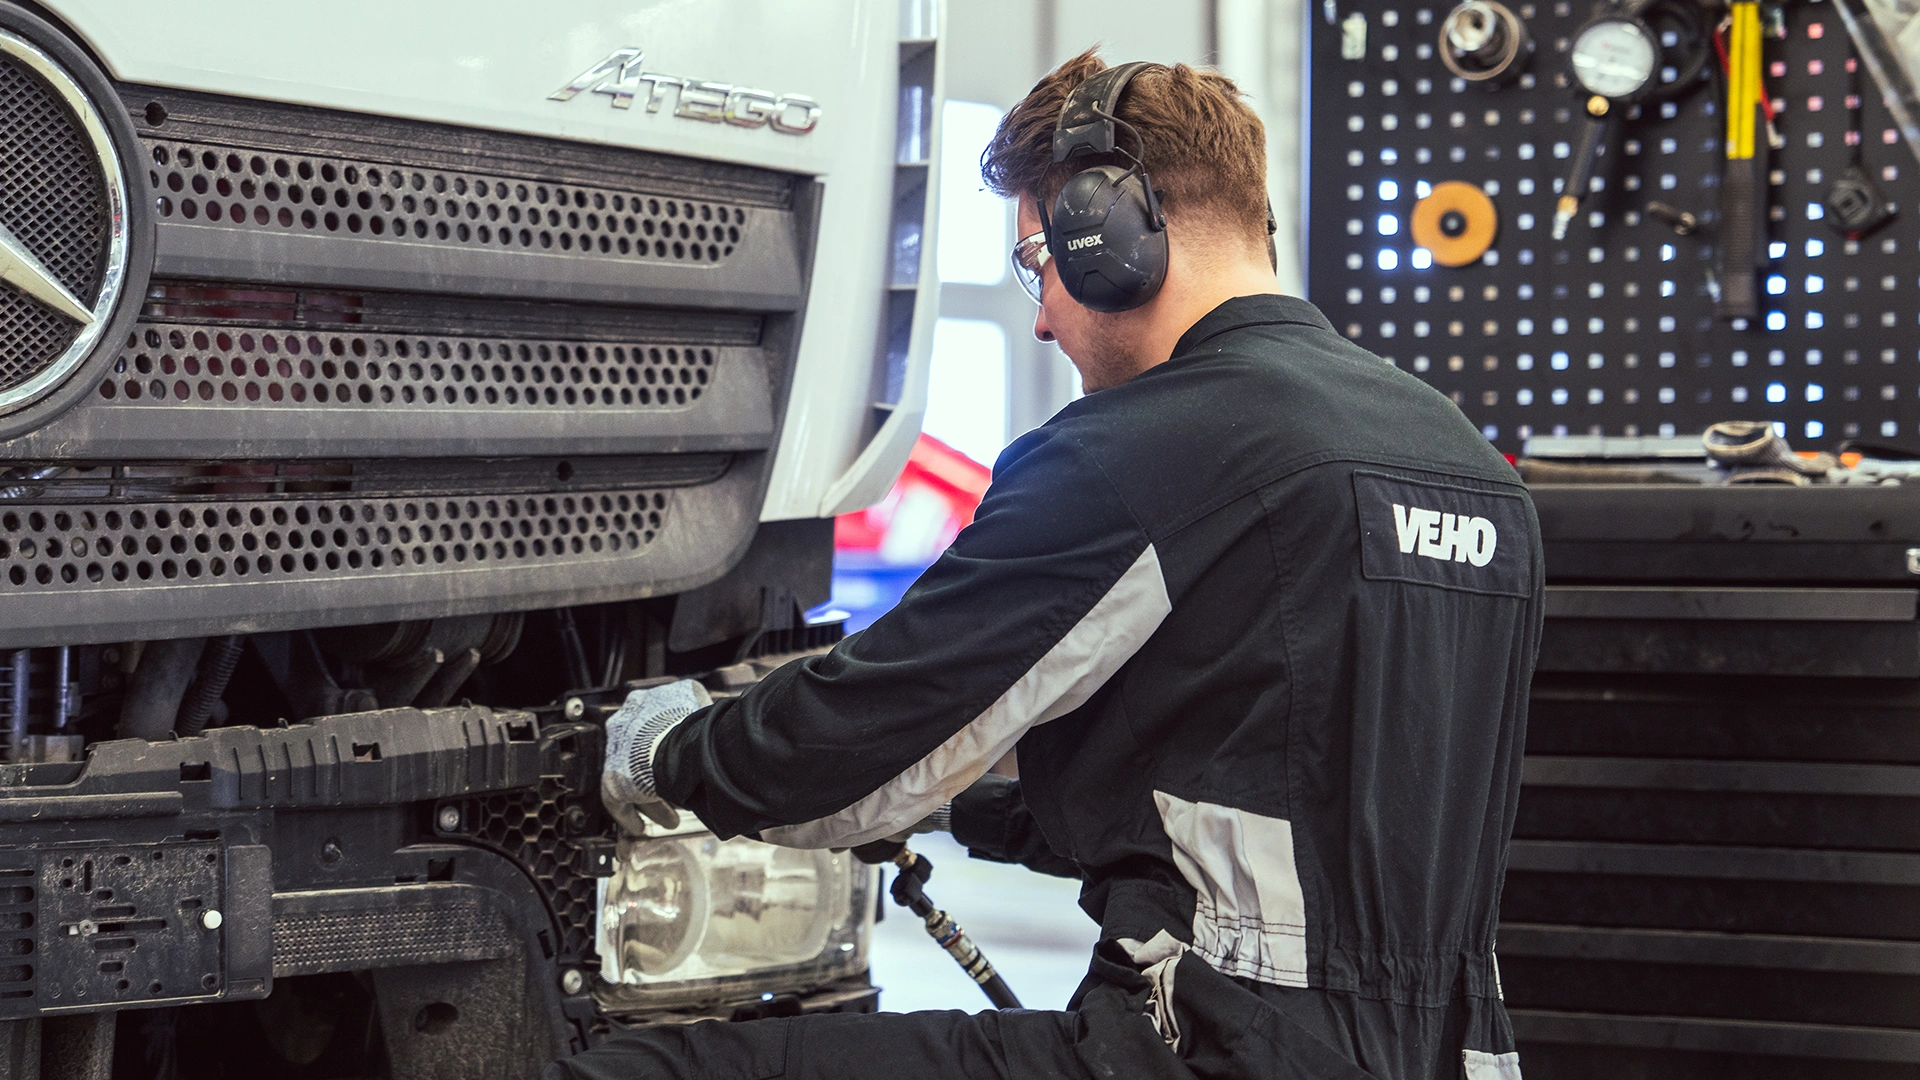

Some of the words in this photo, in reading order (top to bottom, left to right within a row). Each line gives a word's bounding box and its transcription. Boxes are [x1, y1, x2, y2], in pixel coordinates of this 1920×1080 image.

[547, 47, 822, 135] ATEGO
[1067, 233, 1103, 251] uvex
[1392, 503, 1497, 568] VEHO
